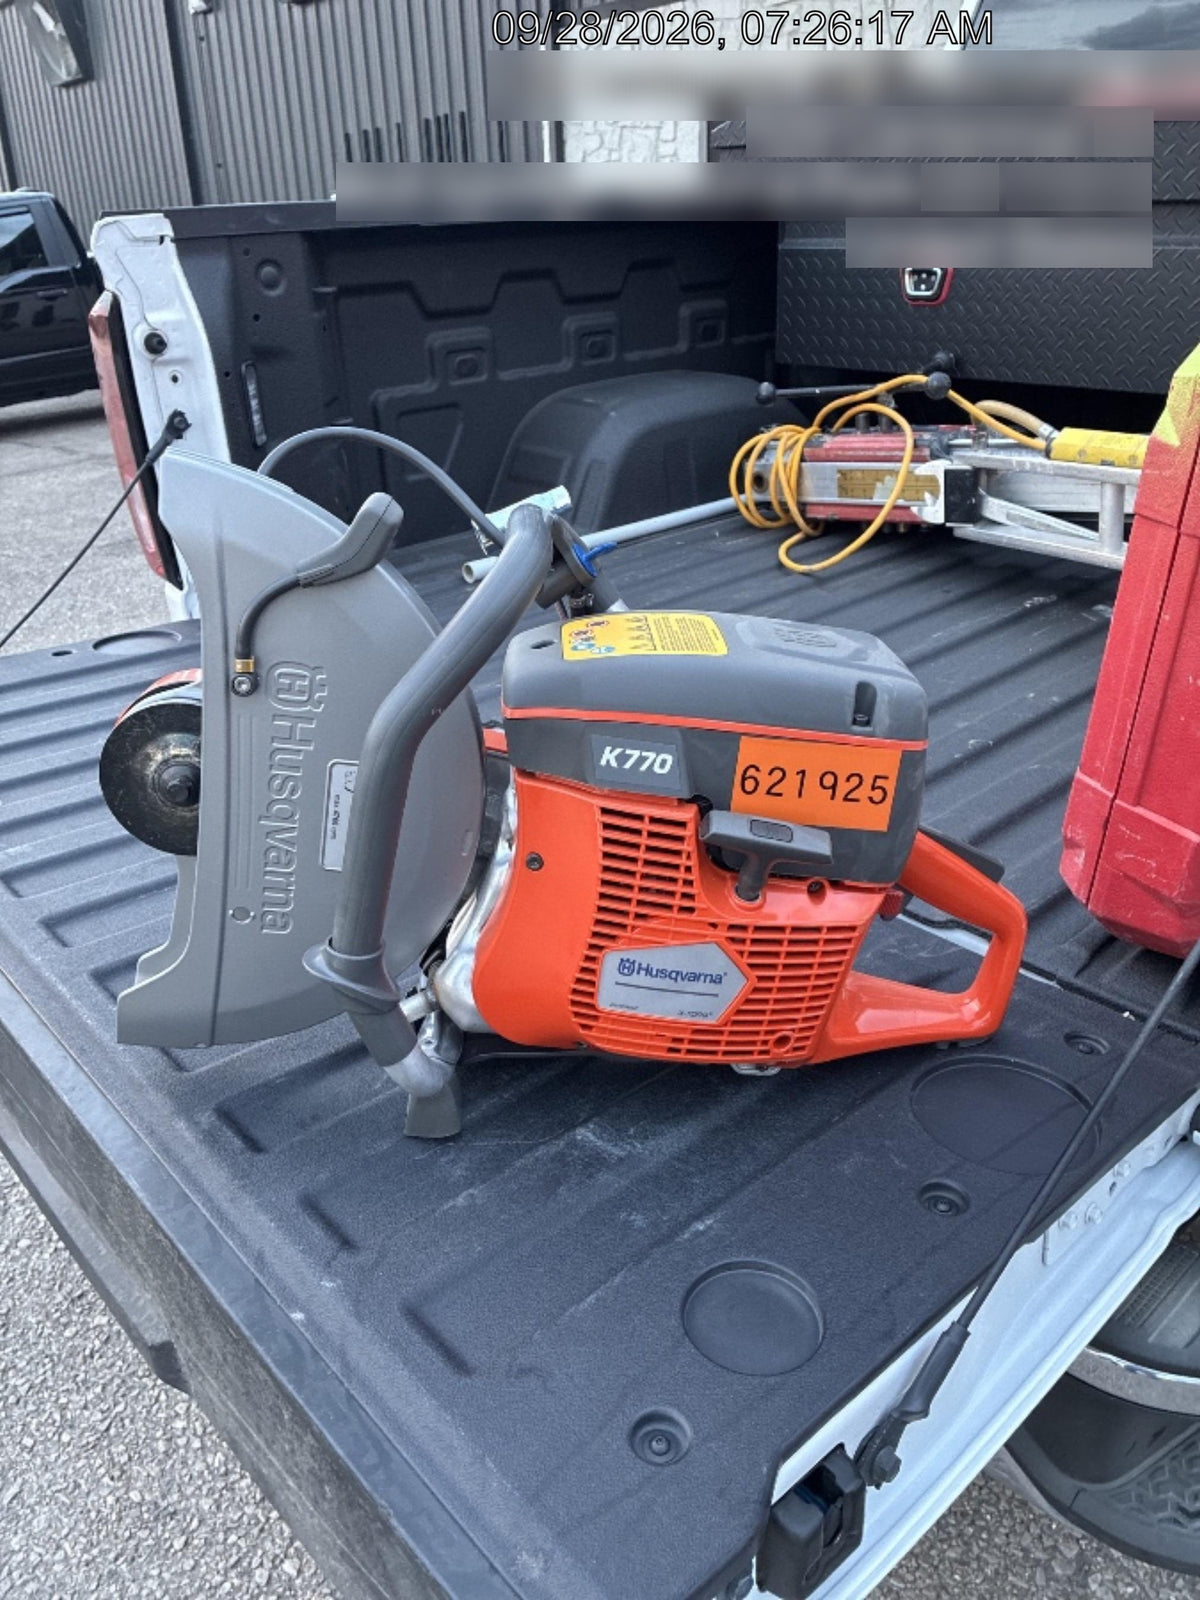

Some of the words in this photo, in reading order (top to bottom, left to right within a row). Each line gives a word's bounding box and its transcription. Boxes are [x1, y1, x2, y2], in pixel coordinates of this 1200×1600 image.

[600, 745, 674, 775] K770
[739, 764, 890, 805] 621925
[258, 713, 317, 935] Husqvarna
[635, 962, 724, 985] Husqvarna
